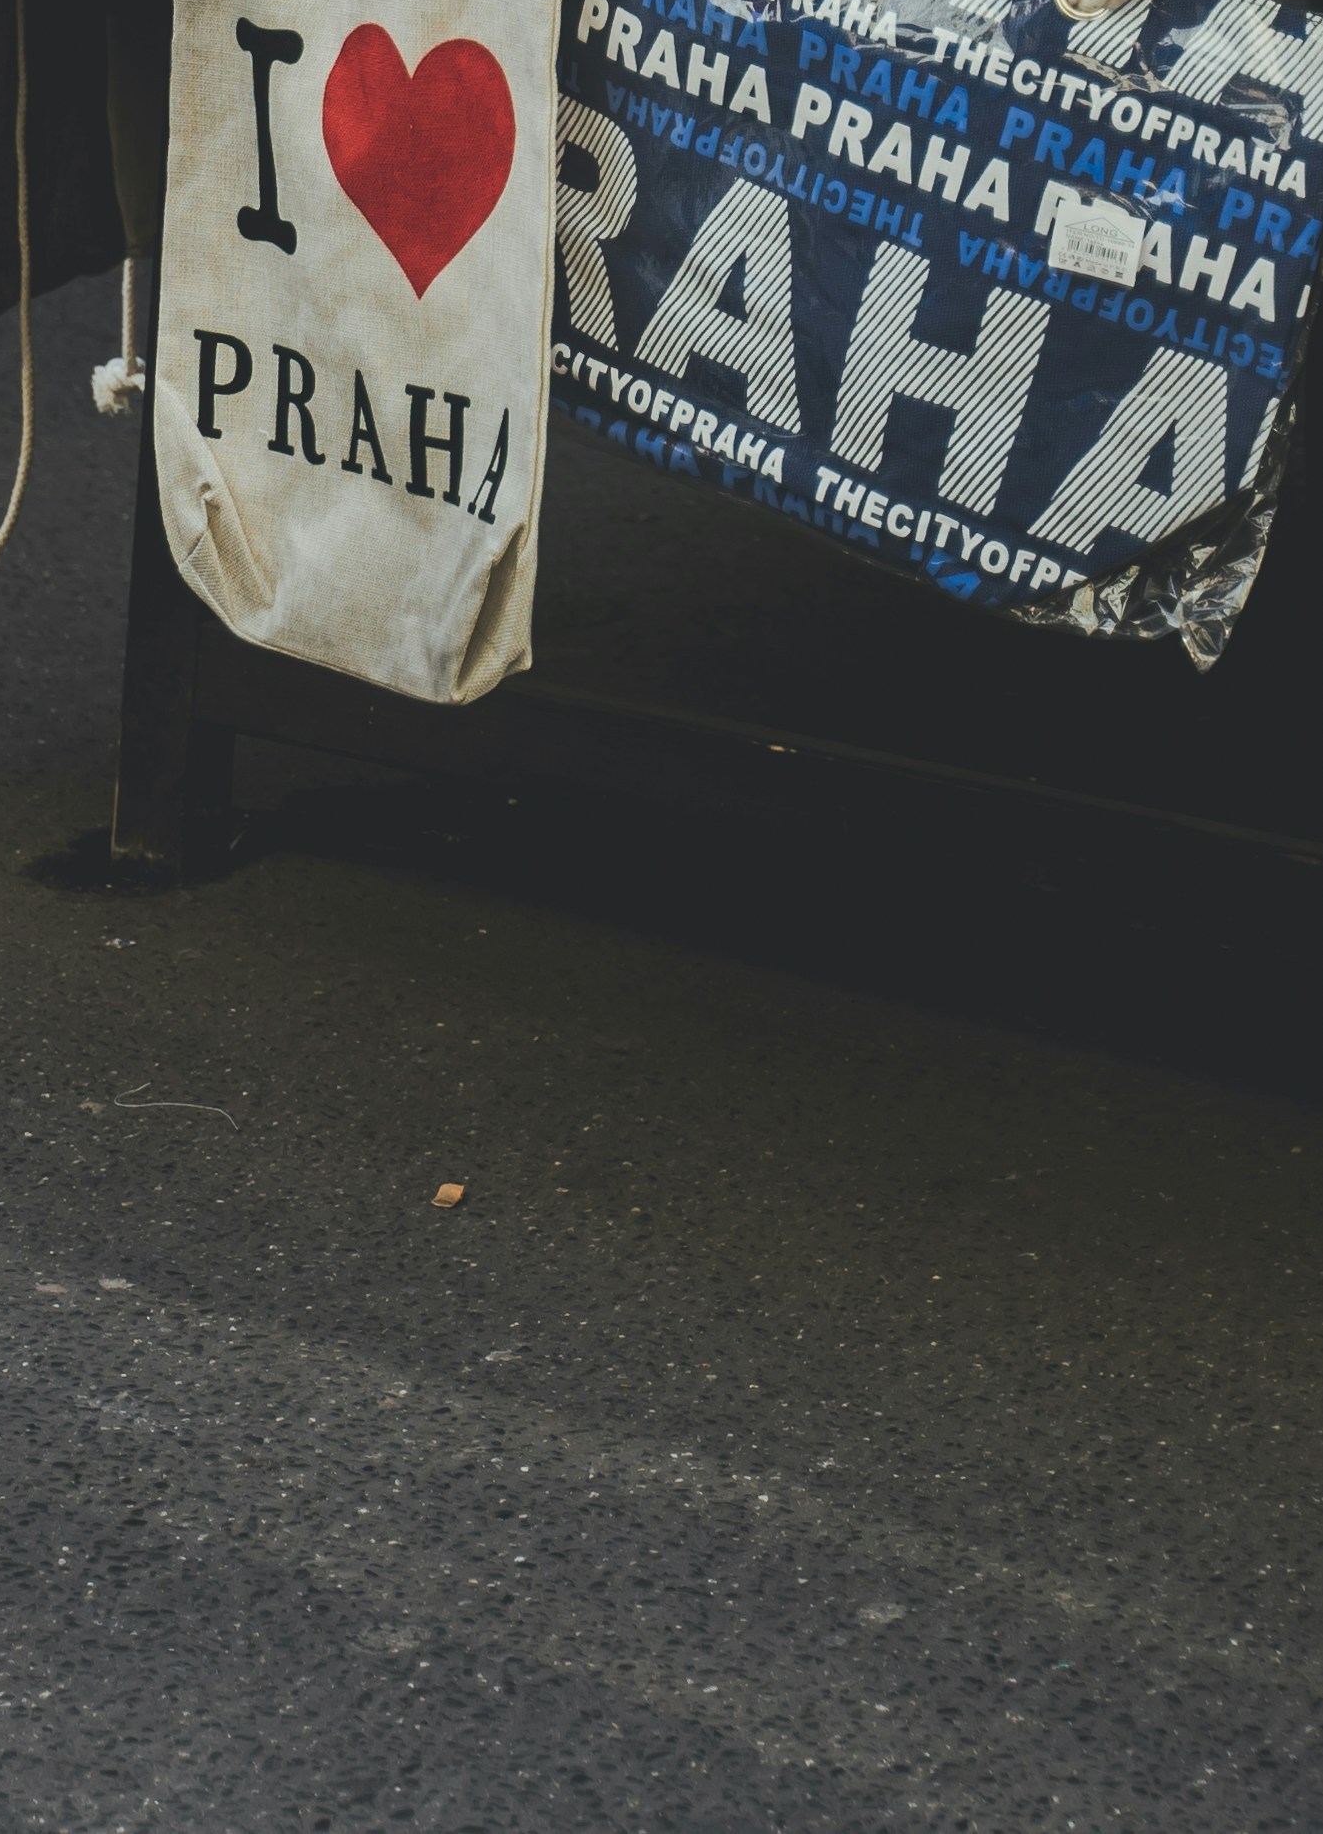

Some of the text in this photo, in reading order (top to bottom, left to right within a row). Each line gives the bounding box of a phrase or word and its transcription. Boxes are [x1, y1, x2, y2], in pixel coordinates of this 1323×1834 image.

[235, 16, 303, 255] I
[791, 82, 1010, 222] PRAHA
[1034, 180, 1276, 323] PAHA
[799, 29, 970, 134] PRAHA
[999, 105, 1186, 216] PRAHA
[931, 26, 1306, 198] THECITYOFPRAHA
[1083, 224, 1118, 237] LONG
[193, 329, 509, 526] PRAHA
